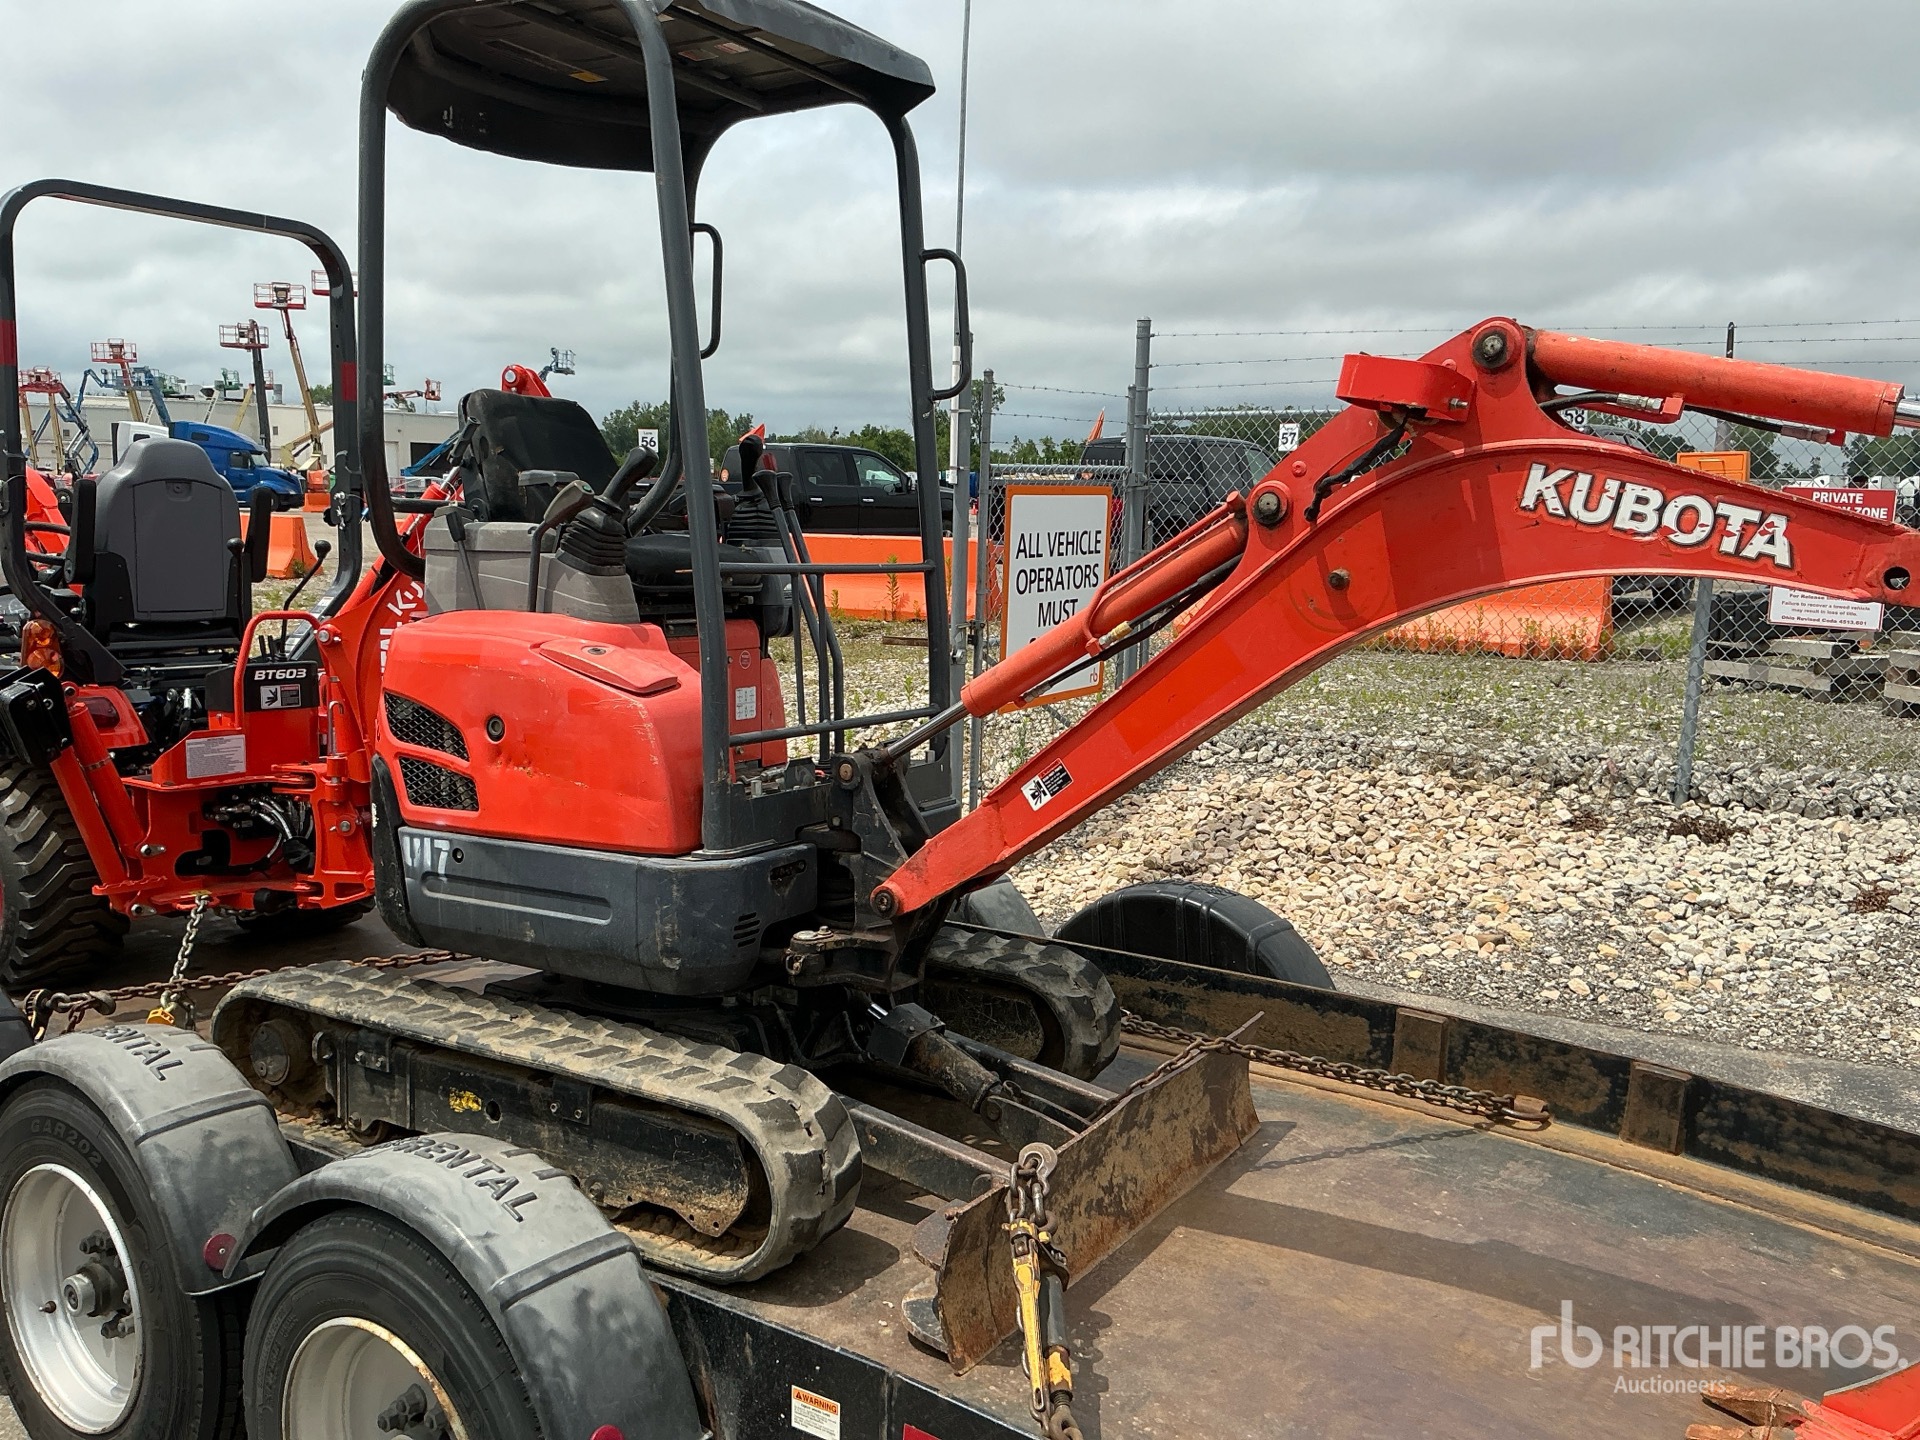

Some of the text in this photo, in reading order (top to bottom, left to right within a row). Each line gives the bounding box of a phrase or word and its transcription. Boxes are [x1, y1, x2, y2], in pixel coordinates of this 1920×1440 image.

[641, 436, 657, 448] 56
[1281, 432, 1297, 445] 57
[1812, 491, 1864, 504] PRIVATE
[1519, 462, 1792, 569] KUBOTA
[1015, 530, 1102, 560] ALL VEHICLE
[1016, 563, 1099, 595] OPERATORS
[1038, 598, 1079, 628] MUST
[254, 668, 307, 681] BT603
[393, 1137, 538, 1223] RENTAL
[802, 1393, 837, 1413] WARNING
